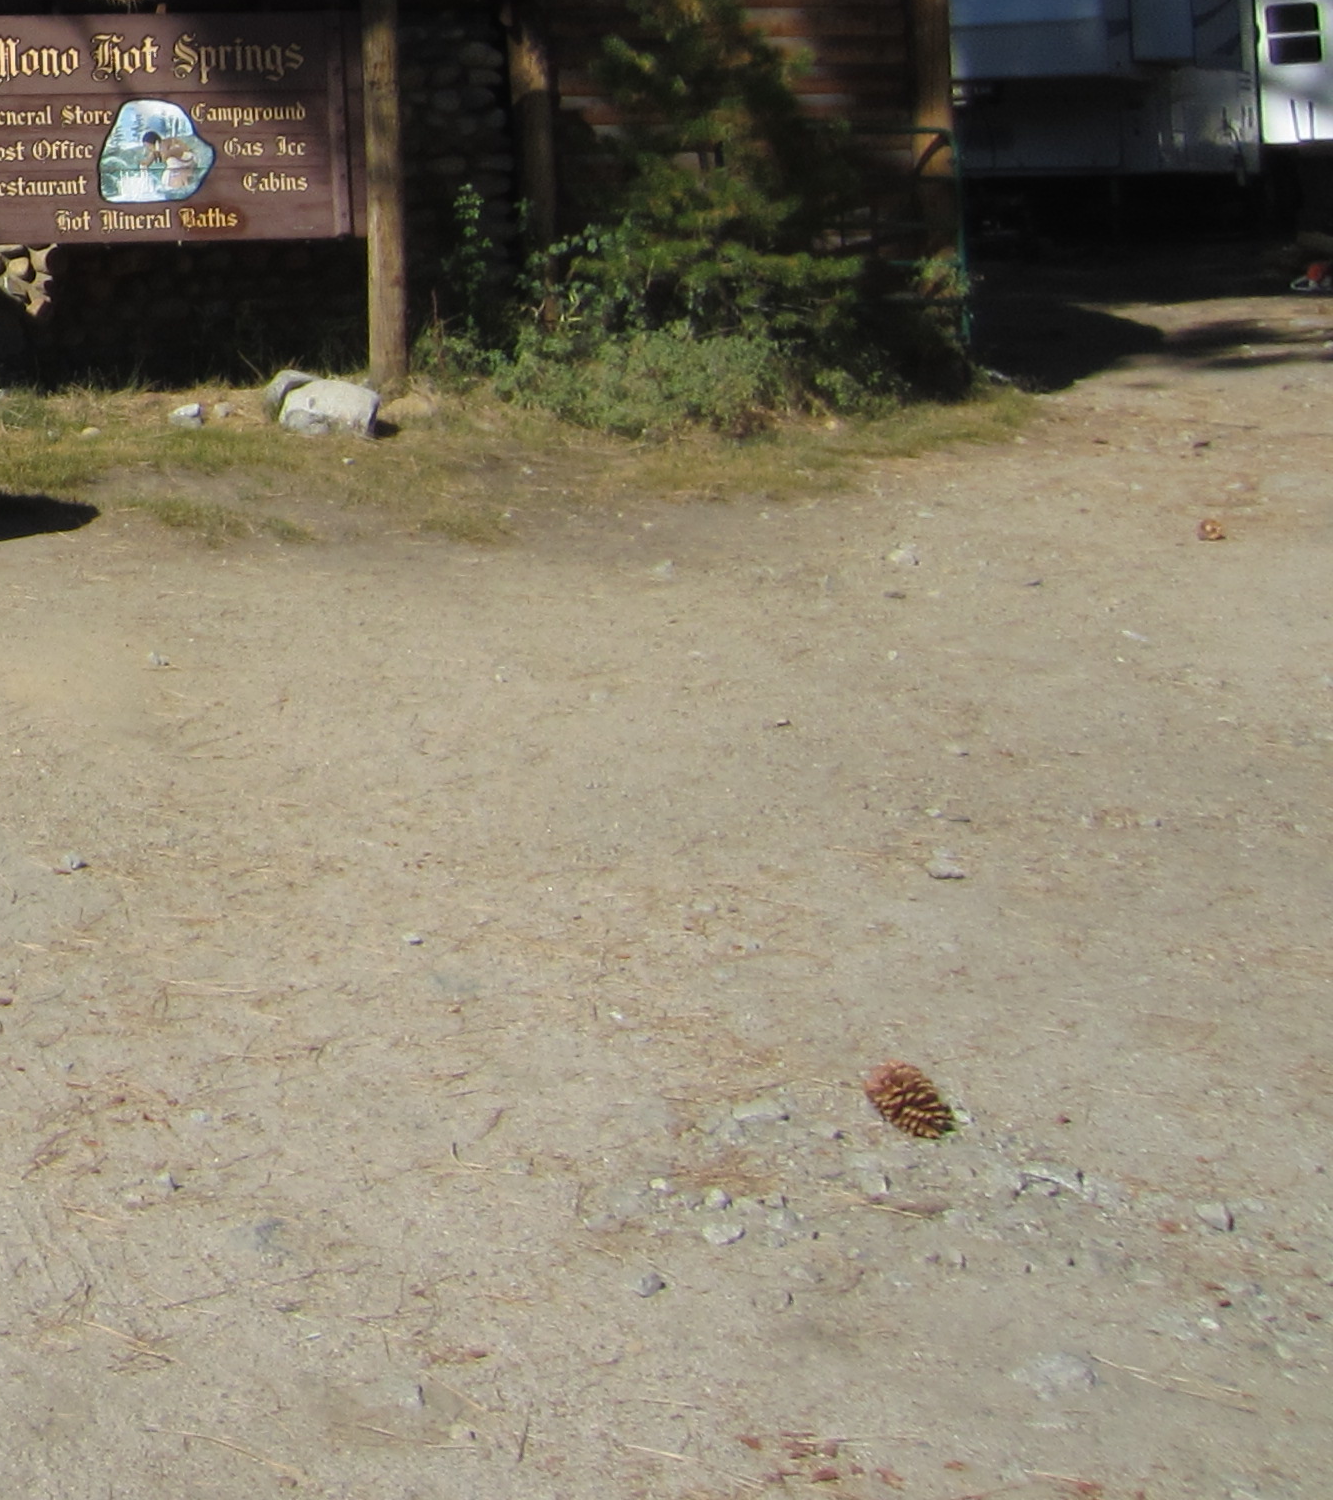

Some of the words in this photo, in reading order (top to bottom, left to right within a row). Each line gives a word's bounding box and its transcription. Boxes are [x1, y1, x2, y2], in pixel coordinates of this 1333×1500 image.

[91, 33, 159, 82] Hot
[172, 33, 305, 85] Springs
[61, 104, 113, 127] Store
[190, 101, 306, 128] Campground
[32, 139, 94, 161] Office
[223, 137, 264, 159] Gas
[276, 136, 306, 156] Ice
[243, 171, 308, 194] Cabins
[55, 208, 91, 234] Hot
[99, 207, 171, 234] Mineral
[178, 207, 239, 231] Baths
